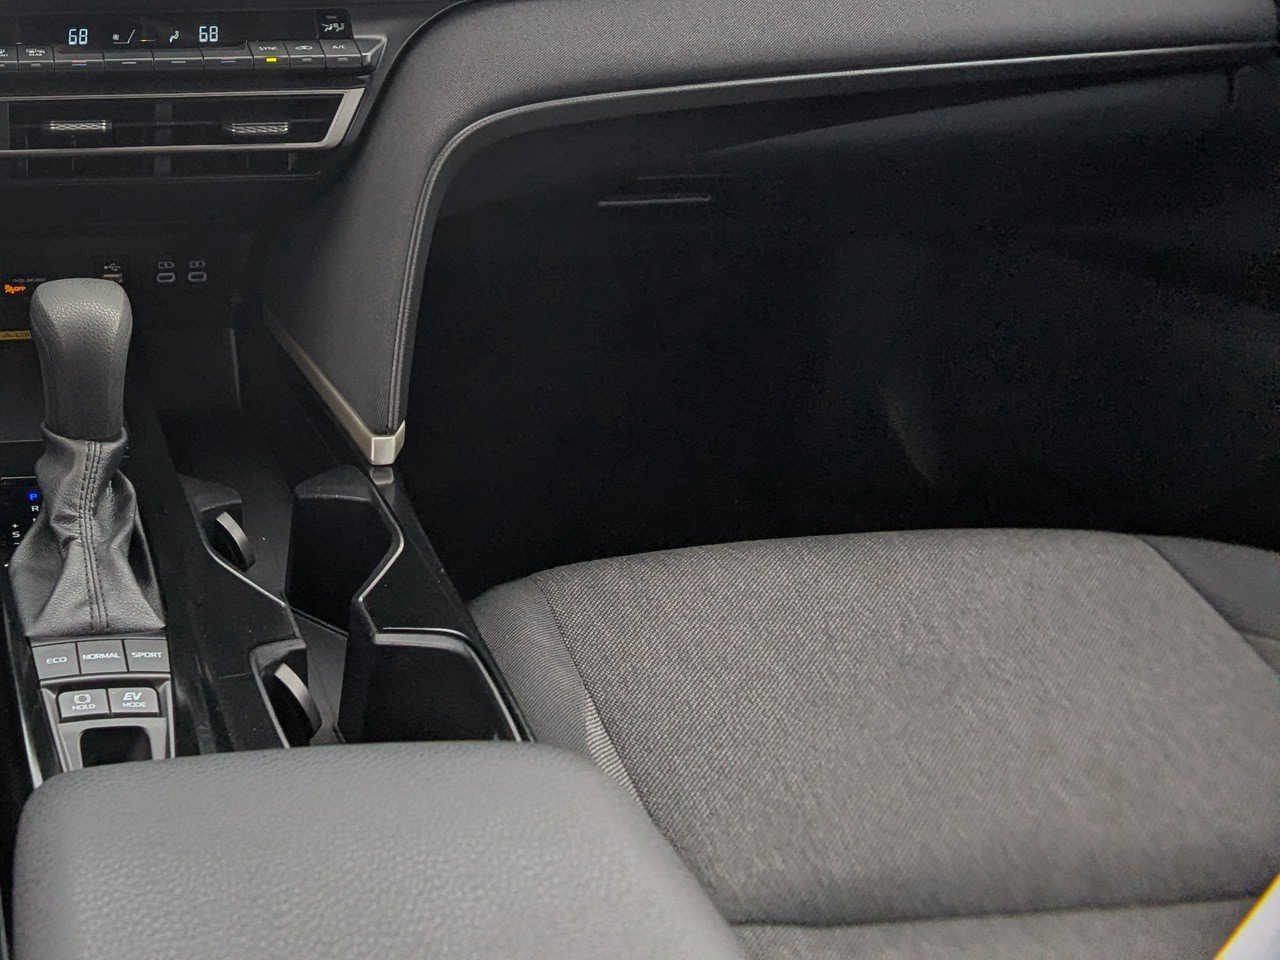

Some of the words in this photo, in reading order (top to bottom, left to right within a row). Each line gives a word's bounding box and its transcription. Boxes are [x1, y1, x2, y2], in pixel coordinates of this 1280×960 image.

[68, 28, 89, 45] 68
[198, 25, 219, 43] 68
[29, 493, 38, 501] P
[82, 651, 121, 660] NORMAL
[131, 651, 163, 659] SPORT
[46, 657, 67, 665] ECO
[122, 692, 142, 701] EV
[71, 703, 96, 711] HOLD
